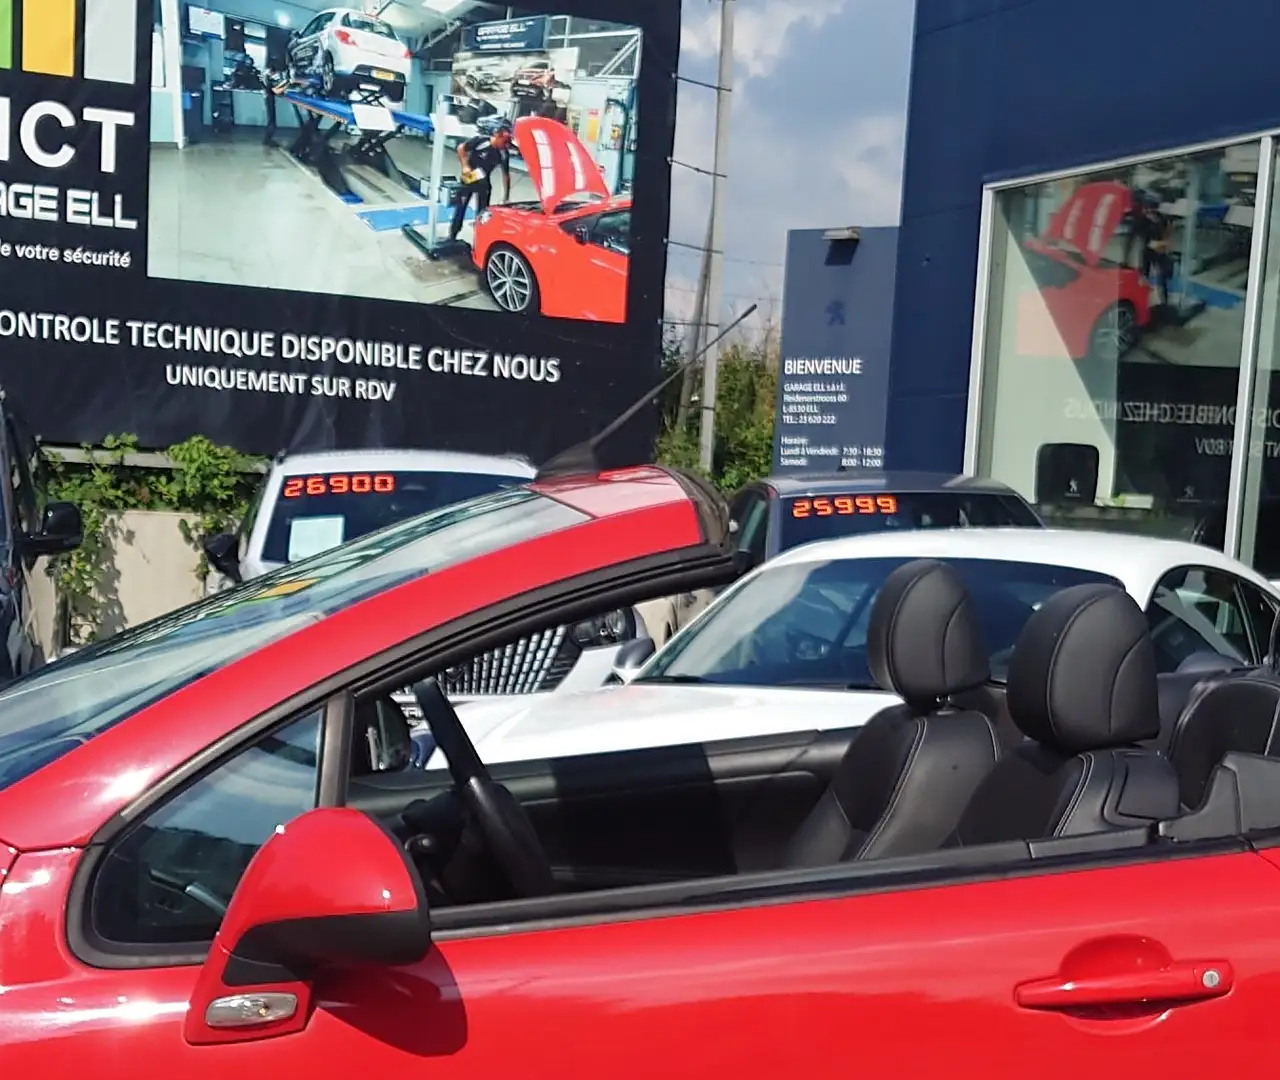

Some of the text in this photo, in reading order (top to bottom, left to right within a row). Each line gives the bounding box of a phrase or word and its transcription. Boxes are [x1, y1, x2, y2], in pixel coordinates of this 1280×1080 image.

[66, 189, 138, 229] ELL
[15, 243, 59, 261] votre
[62, 246, 131, 268] sécurité
[125, 319, 274, 358] TECHNIQUE
[281, 332, 422, 371] DISPONIBLE
[426, 348, 489, 377] CHEZ
[492, 353, 561, 383] NOUS
[784, 359, 862, 374] BIENVENUE
[165, 363, 397, 402] UNIQUEMENT SUR RDV
[784, 383, 812, 392] GARAGE
[813, 382, 825, 392] ELL
[806, 404, 819, 413] ELL
[798, 415, 807, 424] 23
[807, 415, 821, 424] 620
[822, 415, 837, 424] 222
[842, 447, 858, 456] 7:30
[862, 458, 881, 467] 12:00
[283, 474, 395, 499] 26900
[792, 495, 898, 518] 25999
